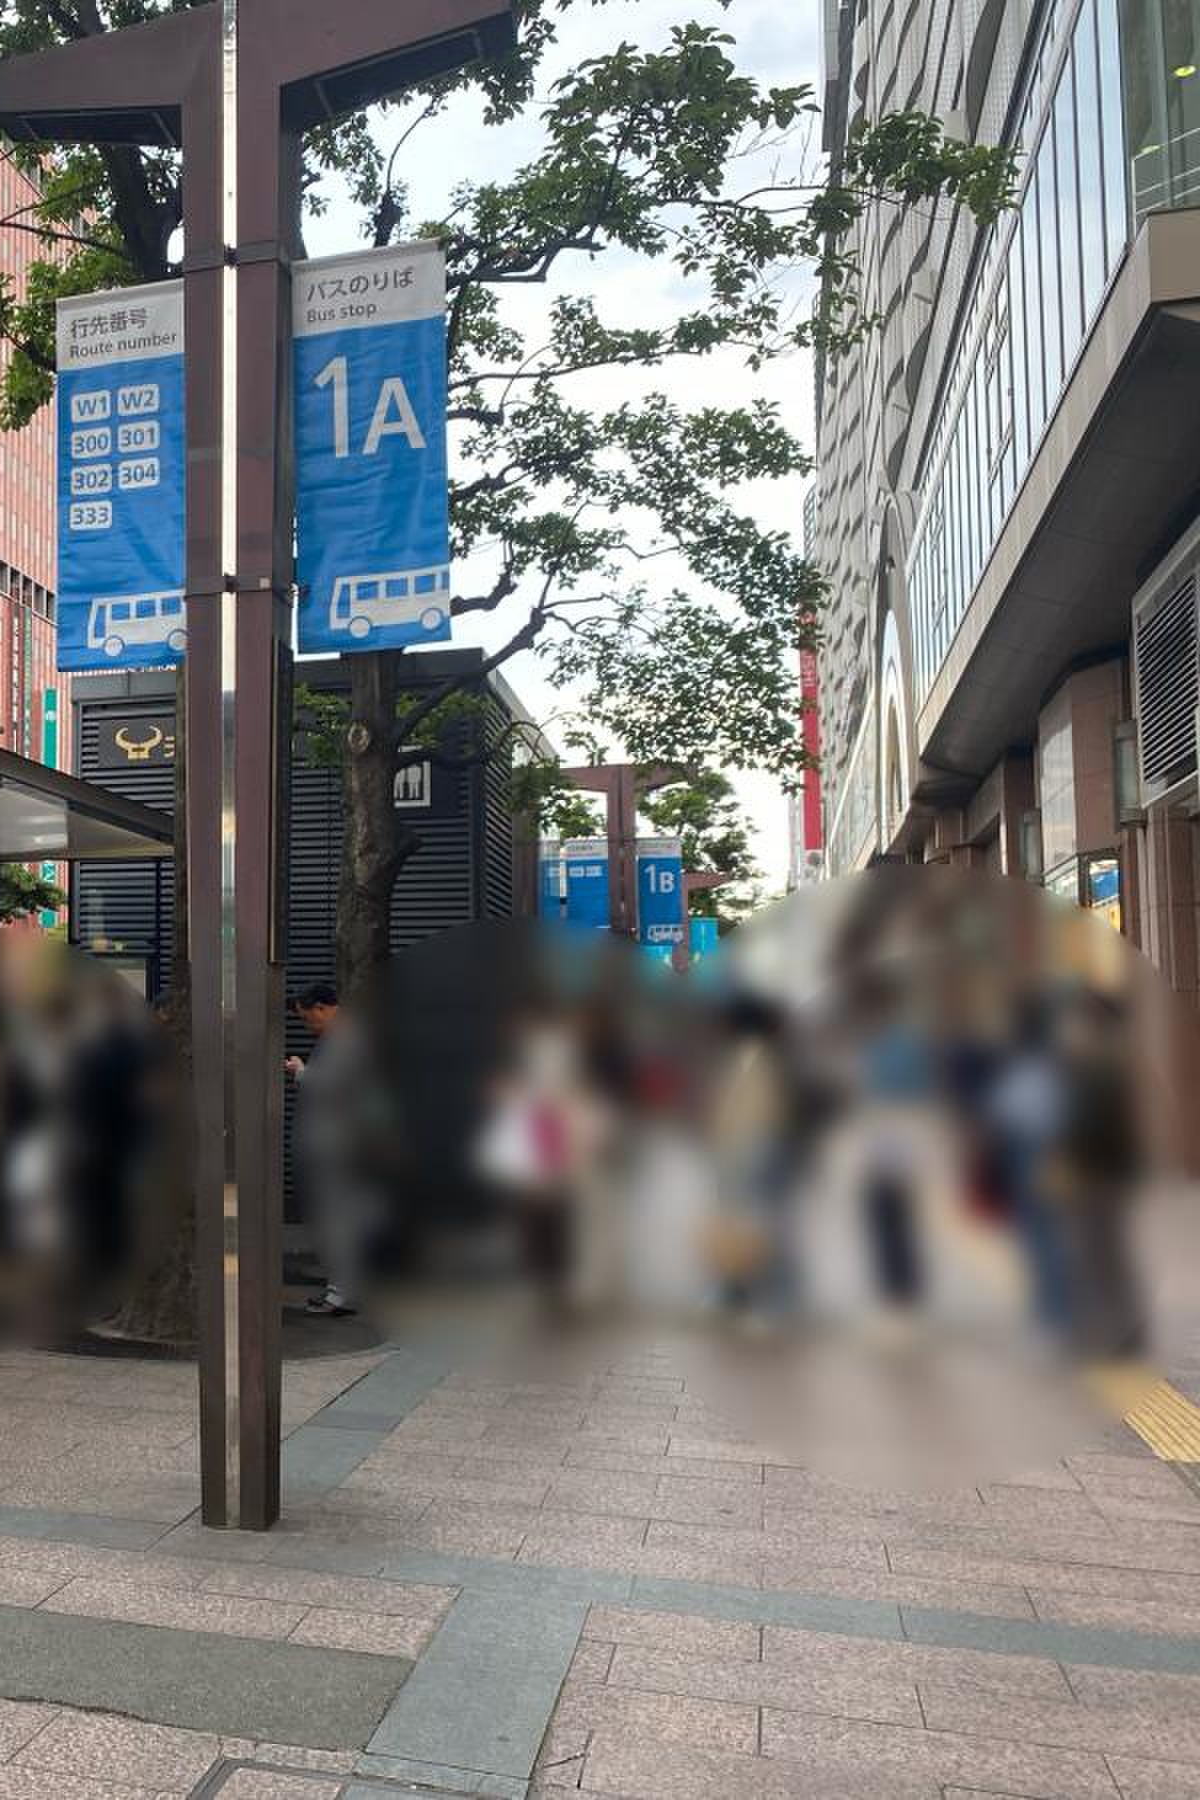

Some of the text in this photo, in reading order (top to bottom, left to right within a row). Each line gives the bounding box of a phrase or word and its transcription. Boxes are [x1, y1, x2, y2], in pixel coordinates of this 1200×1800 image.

[307, 267, 415, 302] バスのりば
[70, 308, 148, 340] 行先番号
[307, 302, 377, 323] Bus stop
[69, 332, 177, 361] Route number
[76, 390, 157, 417] W1 W2
[313, 355, 427, 459] 1A
[73, 426, 156, 453] 300 301
[72, 463, 156, 490] 302 304
[72, 506, 109, 526] 333
[644, 863, 675, 894] 1B
